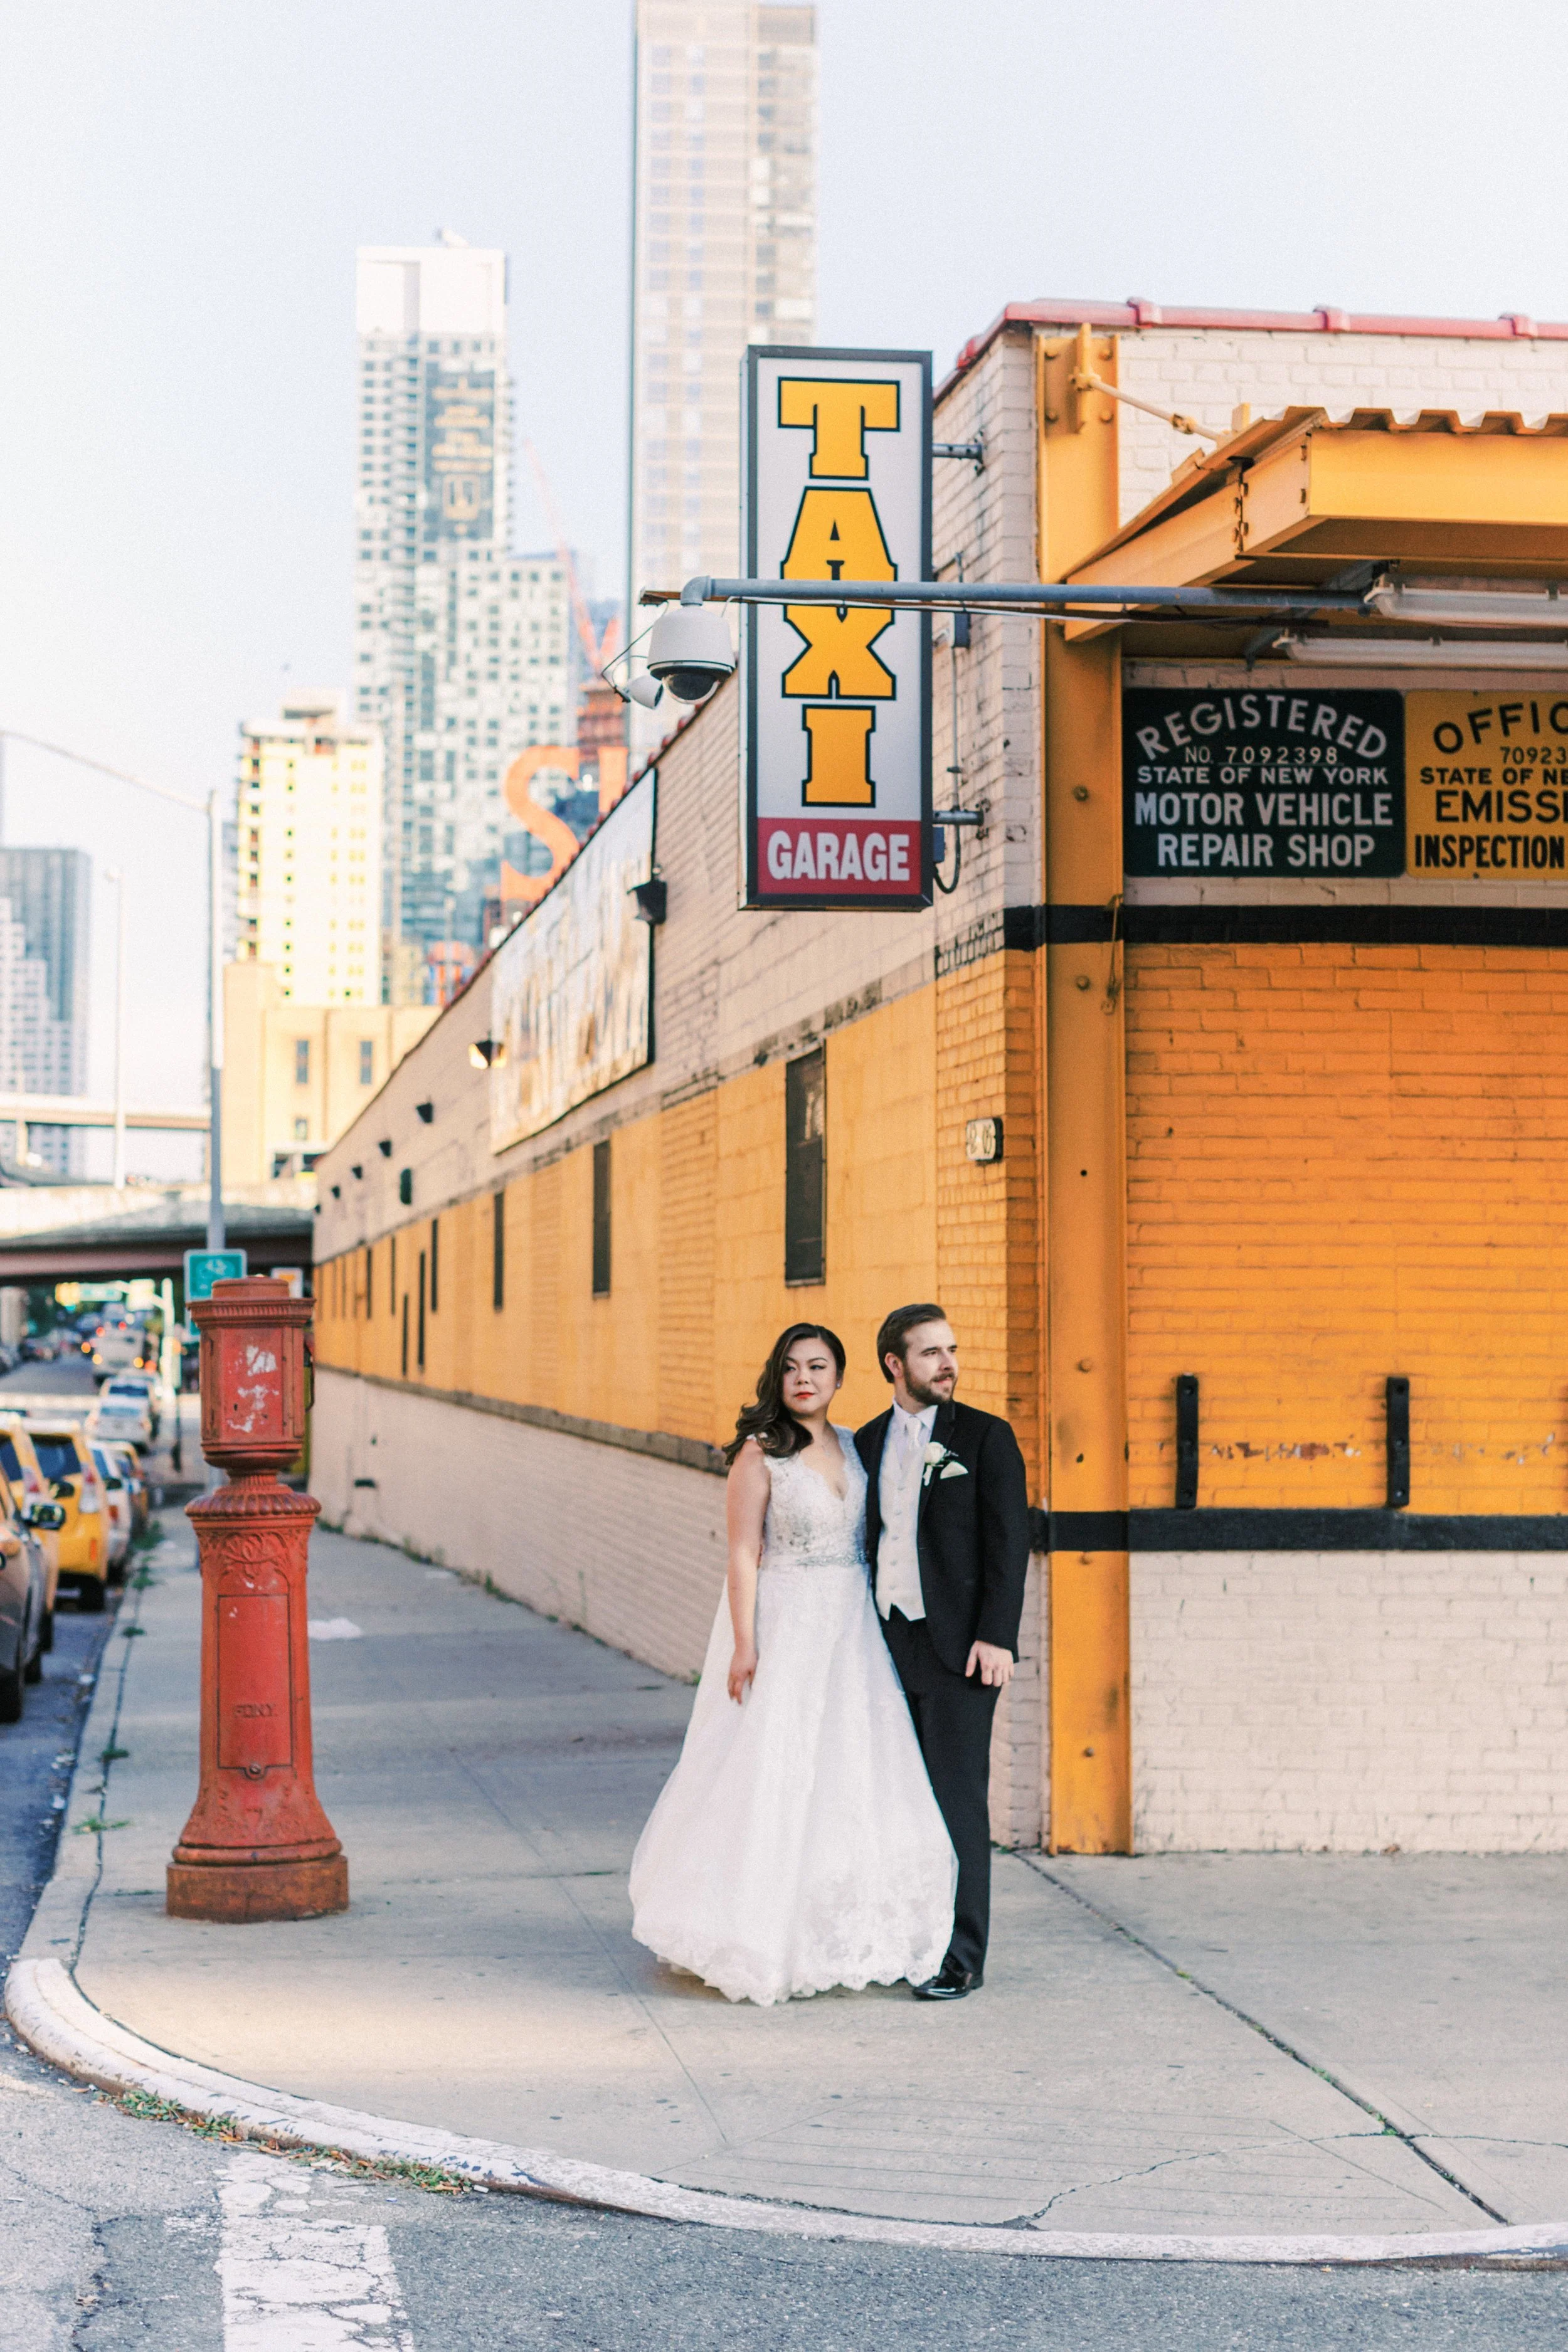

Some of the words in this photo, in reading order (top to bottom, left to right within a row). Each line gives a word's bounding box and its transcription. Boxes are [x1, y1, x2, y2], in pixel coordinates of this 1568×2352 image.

[778, 377, 900, 807] TAXI
[1136, 694, 1387, 761] REGISTERED
[1226, 746, 1337, 764] 7092398
[1138, 766, 1210, 785] STATE
[1220, 766, 1251, 785] OF
[1261, 767, 1313, 785] NEW
[1323, 767, 1389, 785] YORK
[1420, 766, 1492, 785] STATE
[1502, 767, 1534, 785] OF
[1135, 792, 1244, 825] MOTOR
[1255, 793, 1393, 826] VEHICLE
[767, 830, 909, 881] GARAGE
[1158, 833, 1273, 867] REPAIR
[1287, 834, 1375, 867] SHOP
[1414, 834, 1565, 869] INSPECTION
